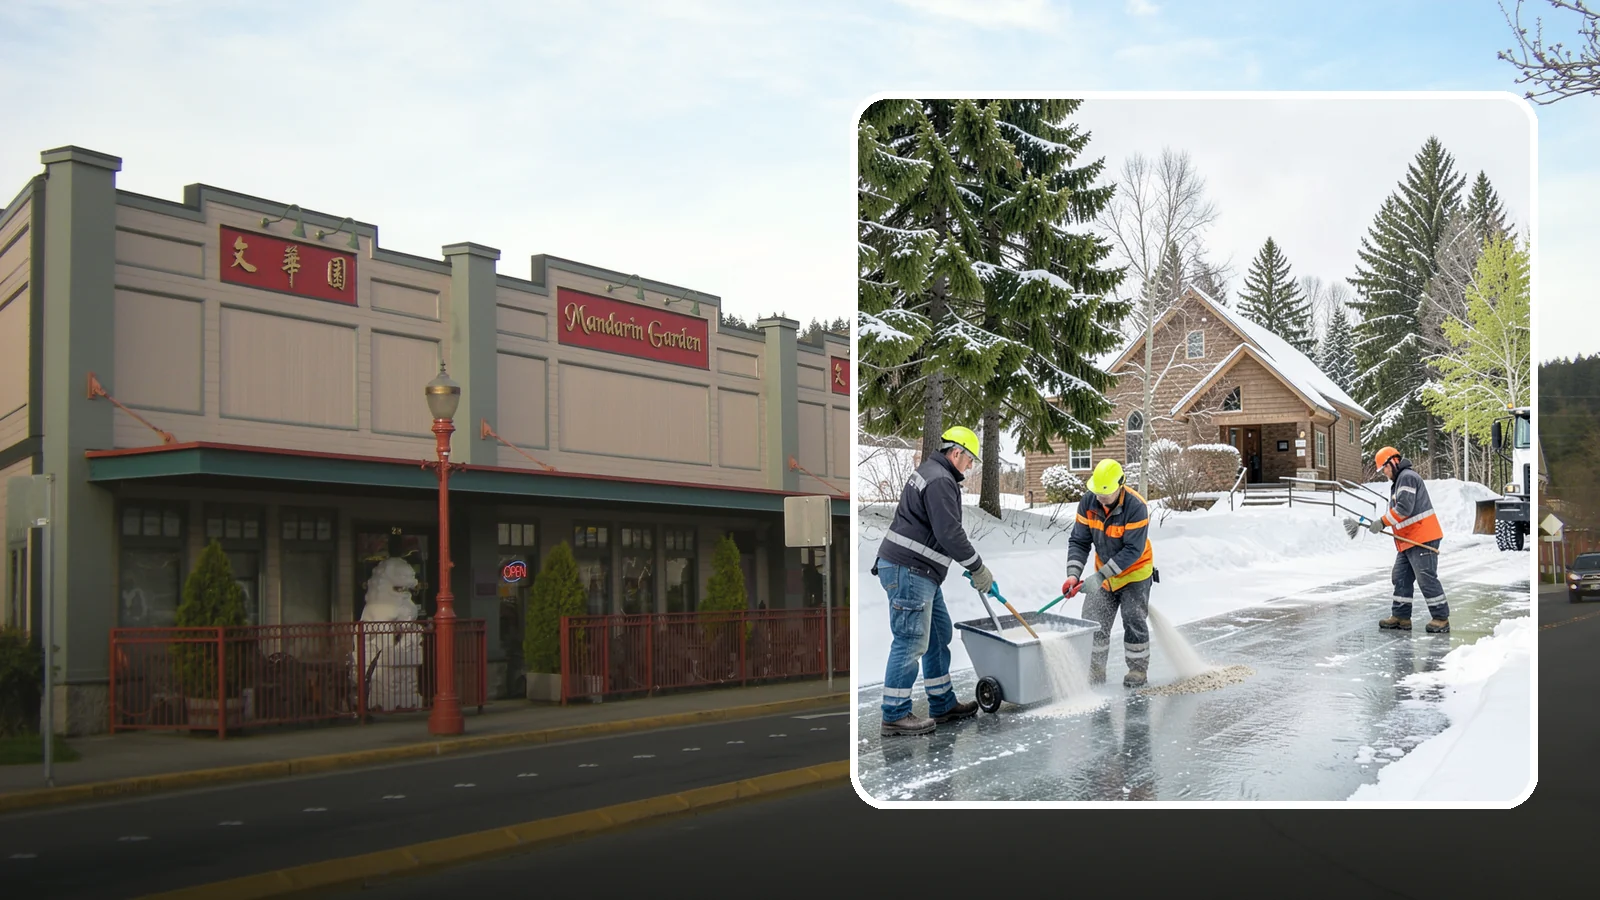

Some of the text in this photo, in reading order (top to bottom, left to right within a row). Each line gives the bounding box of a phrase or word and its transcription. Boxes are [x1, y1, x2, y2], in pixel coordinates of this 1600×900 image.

[230, 235, 346, 291] 文華園
[564, 302, 701, 352] Mandarin Garden
[503, 565, 527, 578] OPEN
